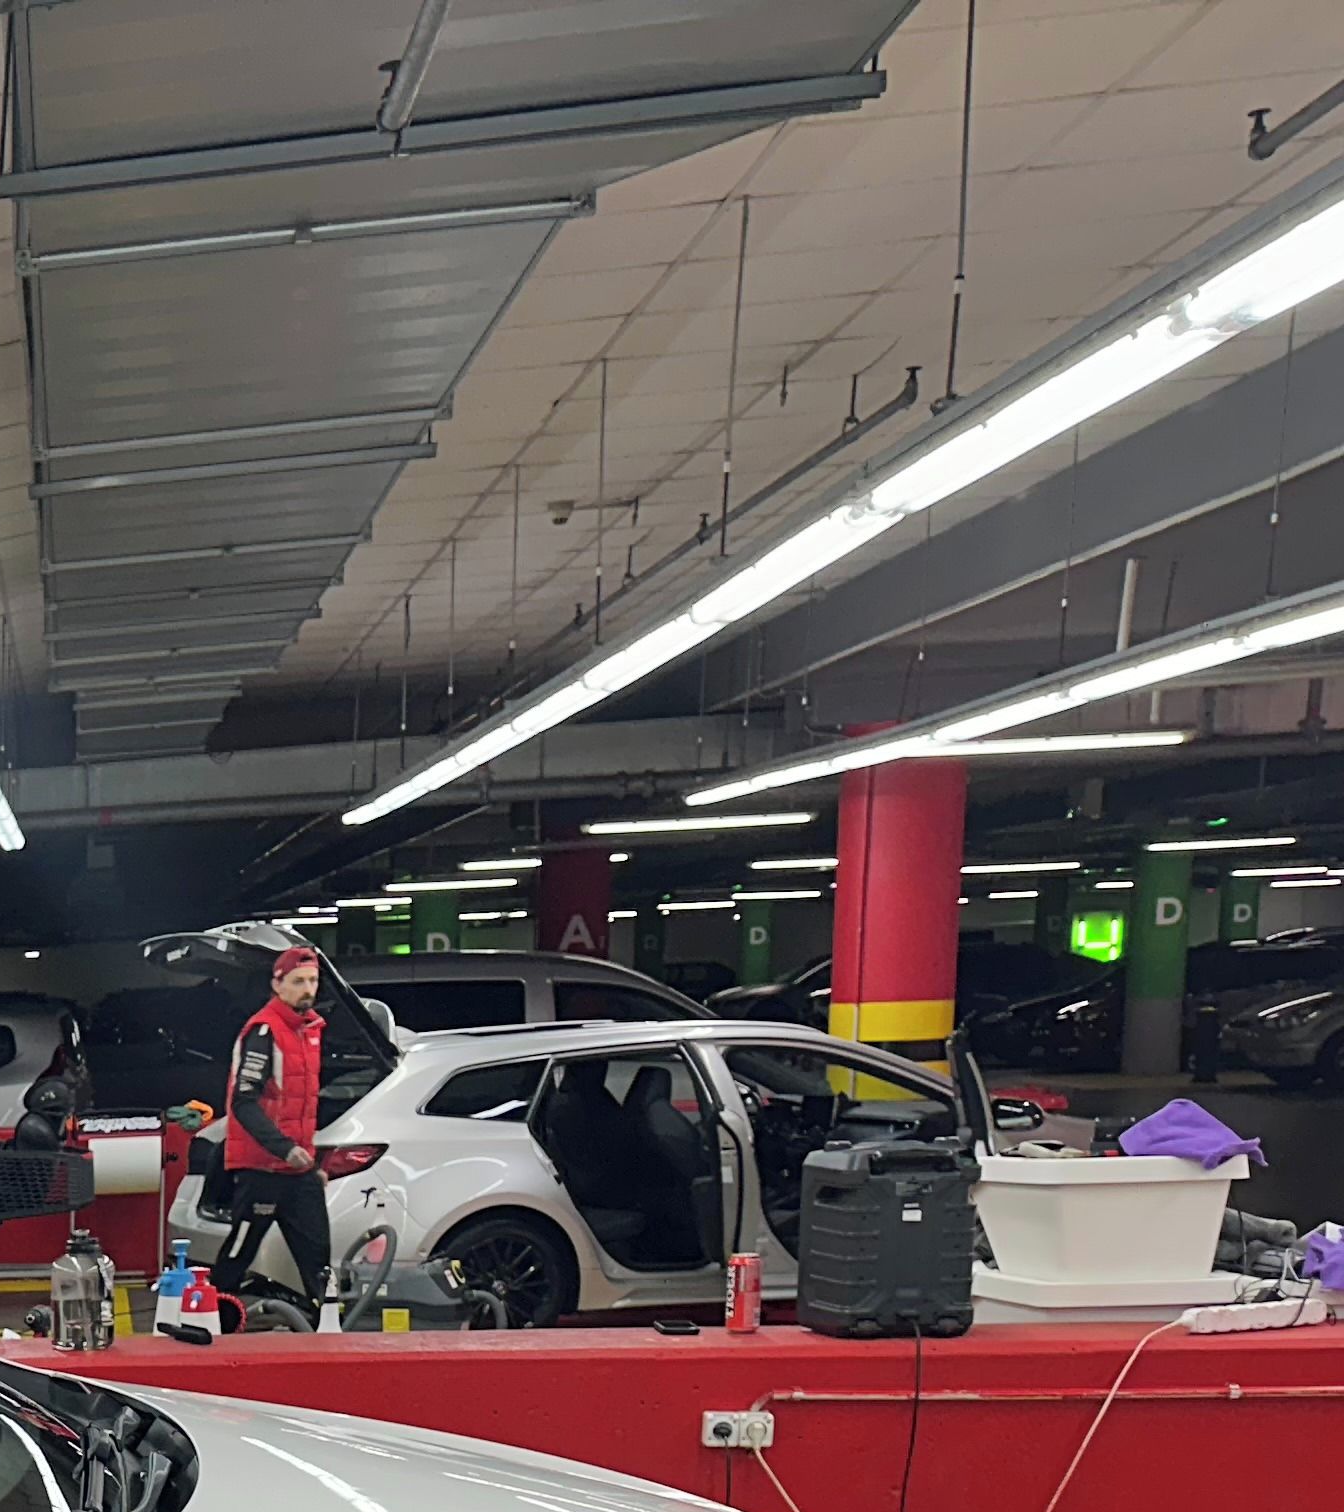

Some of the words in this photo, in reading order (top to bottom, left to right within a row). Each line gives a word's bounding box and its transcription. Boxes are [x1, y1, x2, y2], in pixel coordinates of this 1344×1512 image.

[1155, 897, 1183, 926] D
[1233, 903, 1252, 923] D
[750, 926, 768, 945] D
